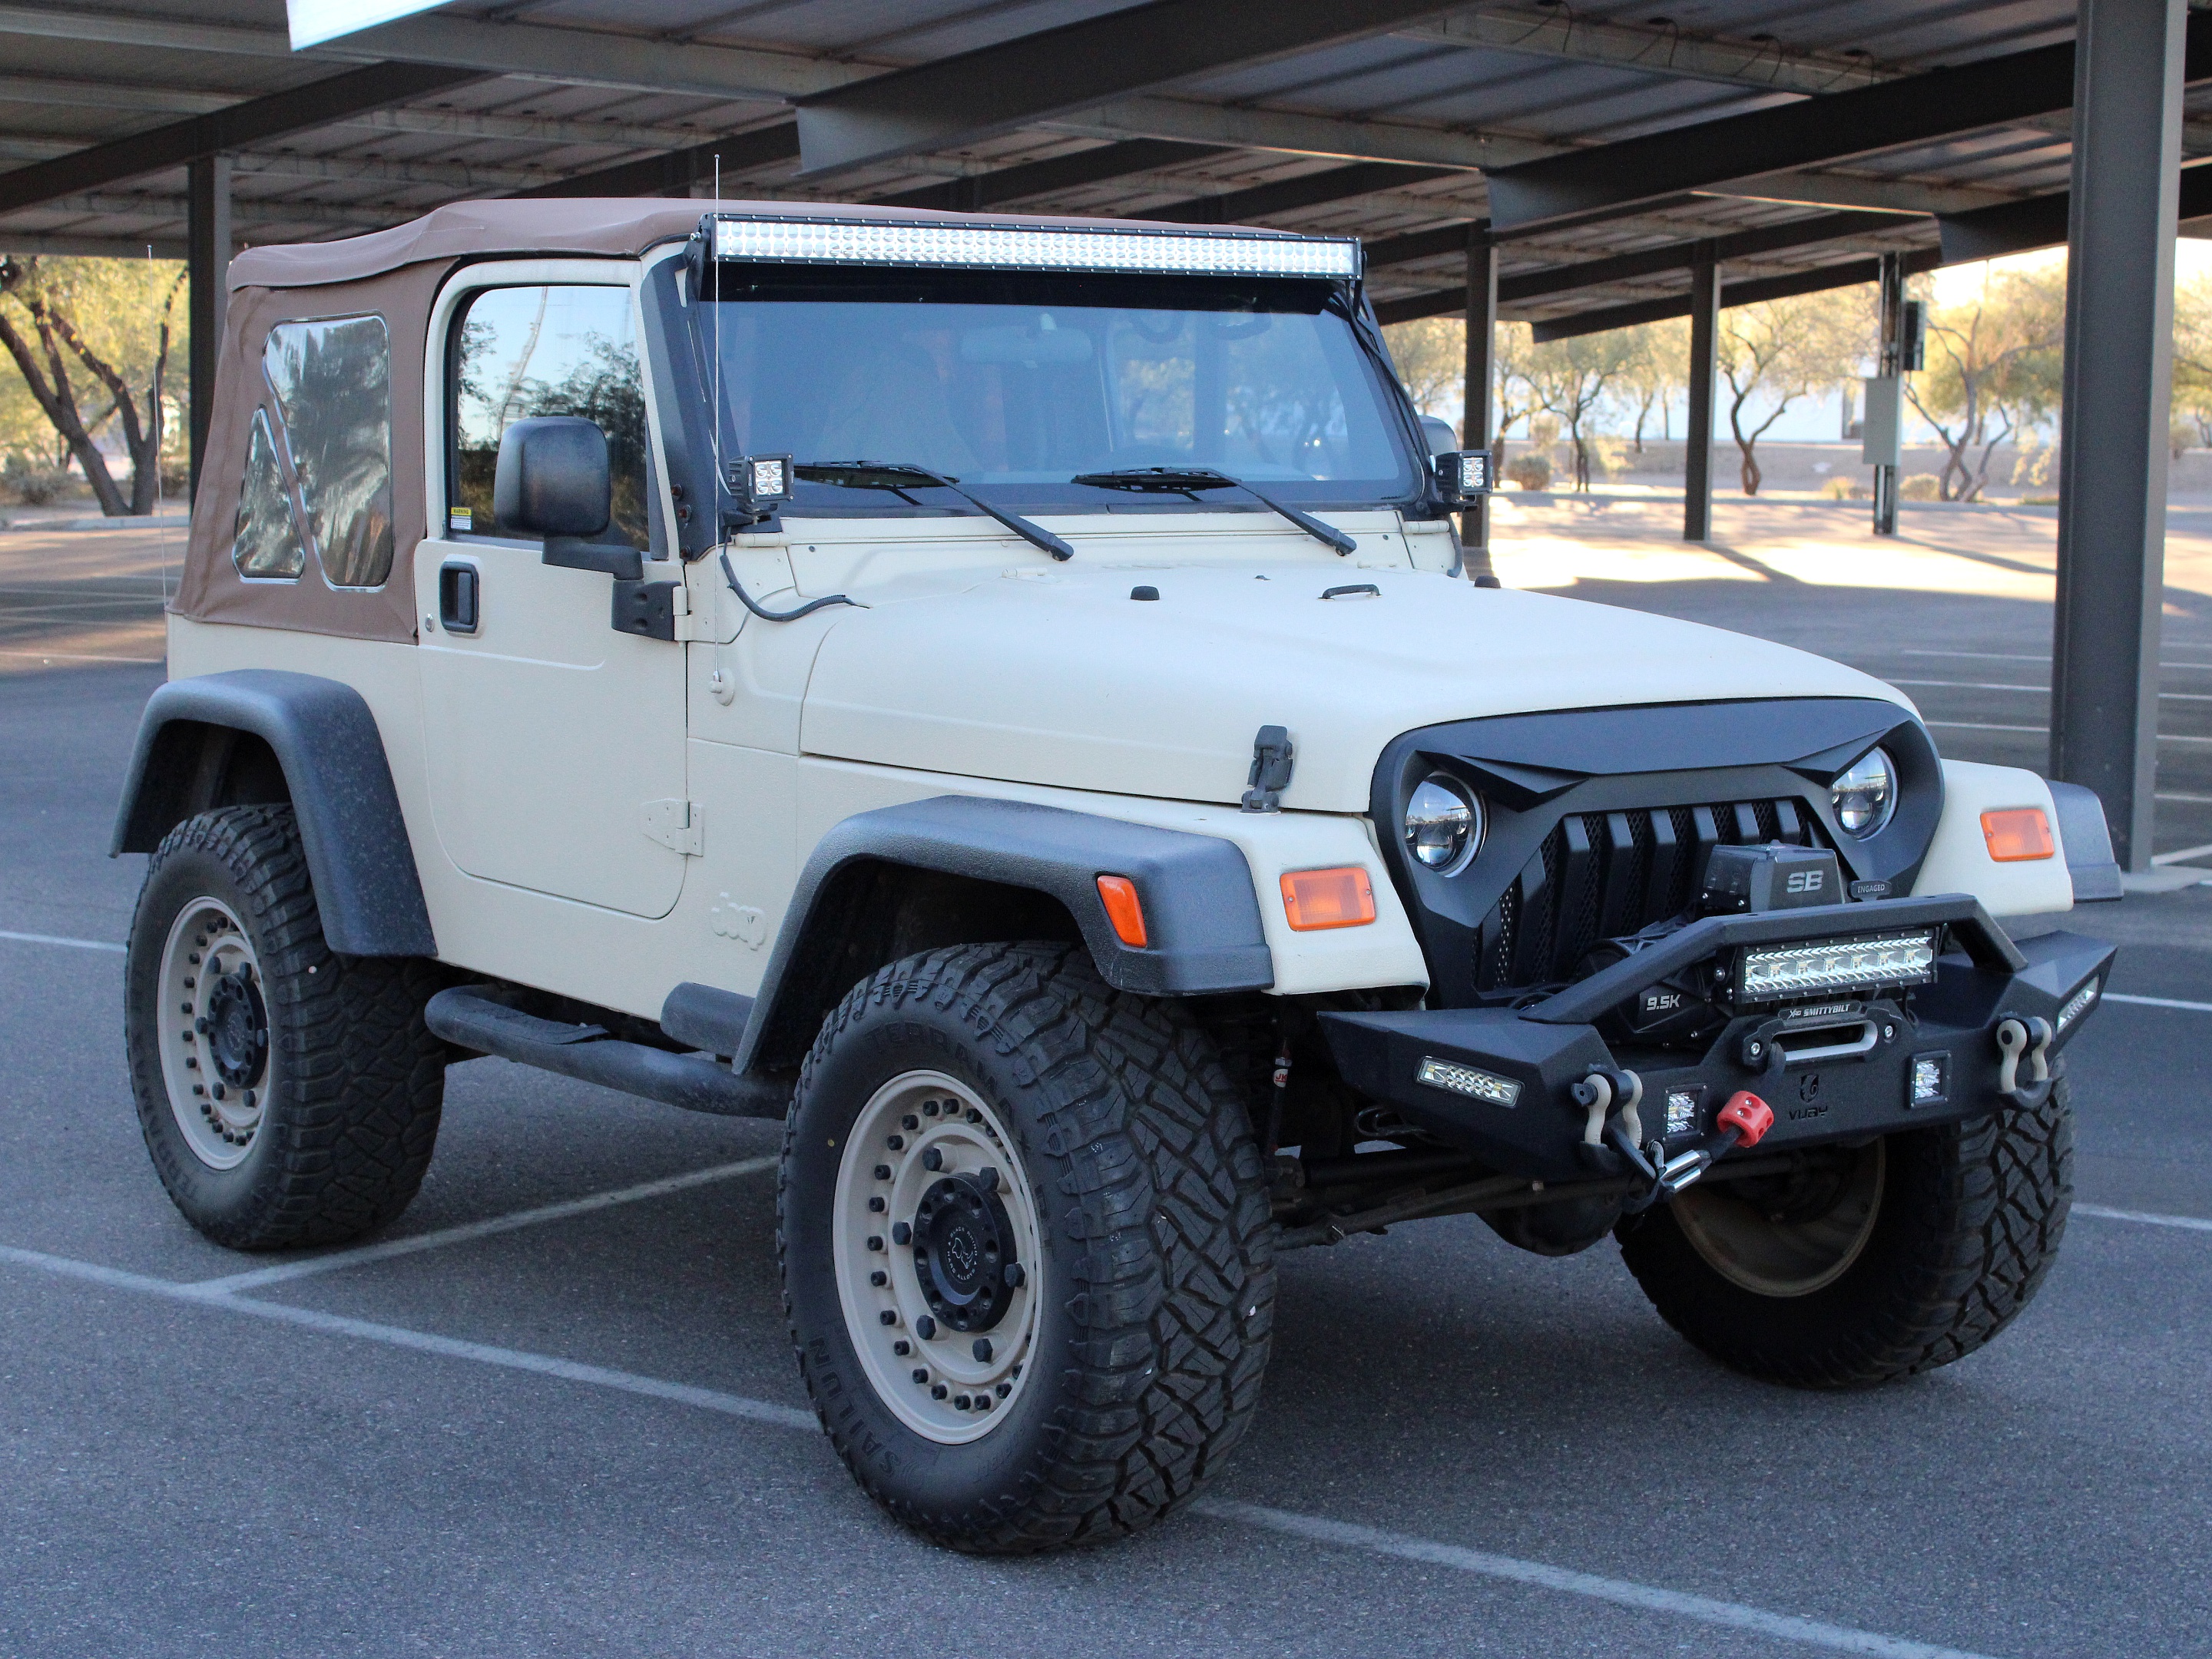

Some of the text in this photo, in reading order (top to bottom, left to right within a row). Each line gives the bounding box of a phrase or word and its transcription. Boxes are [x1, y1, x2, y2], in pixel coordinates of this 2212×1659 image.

[1786, 870, 1824, 892] SB
[1857, 884, 1885, 893] ENGAGED
[1646, 994, 1681, 1011] 9.5K
[1803, 1003, 1850, 1017] SMITTYBILT
[949, 1226, 965, 1238] BLACK
[808, 1336, 902, 1475] SAILUN
